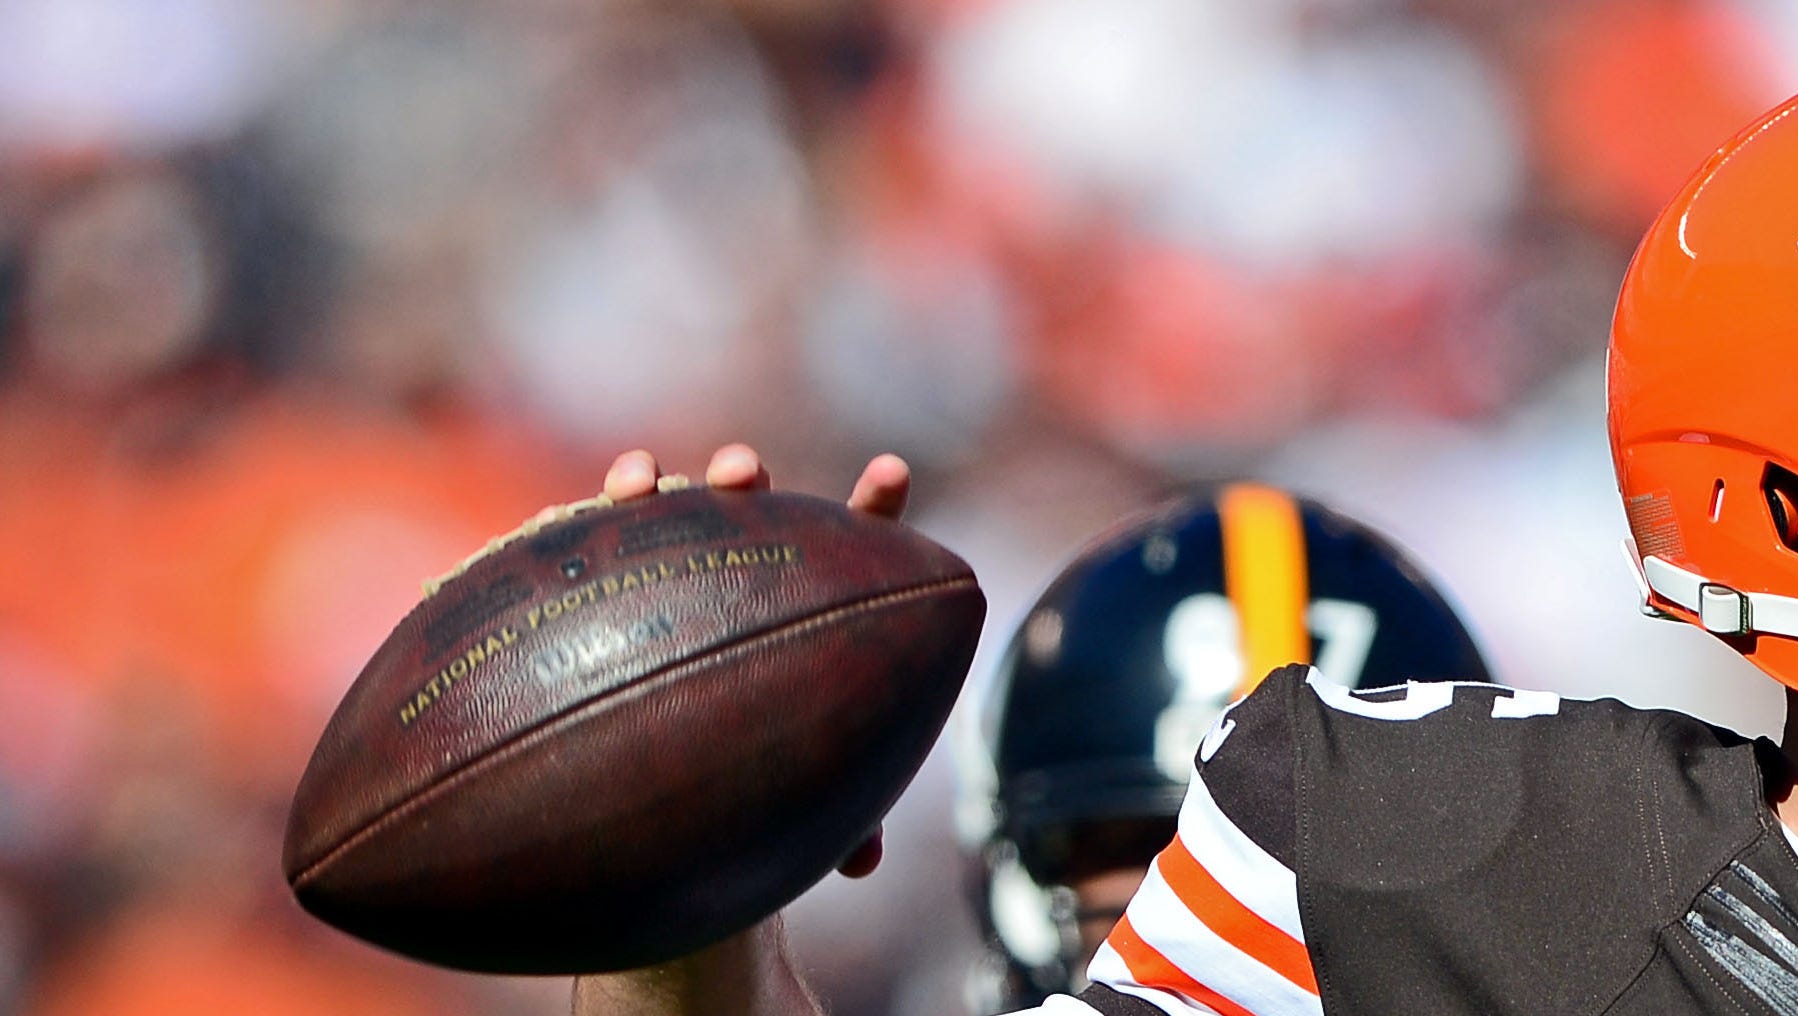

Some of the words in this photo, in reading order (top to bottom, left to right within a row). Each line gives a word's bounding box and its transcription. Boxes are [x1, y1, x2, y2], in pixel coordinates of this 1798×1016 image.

[401, 626, 518, 725] NATIONAL
[527, 562, 674, 630] FOOTBALL
[687, 545, 797, 573] LEAGUE
